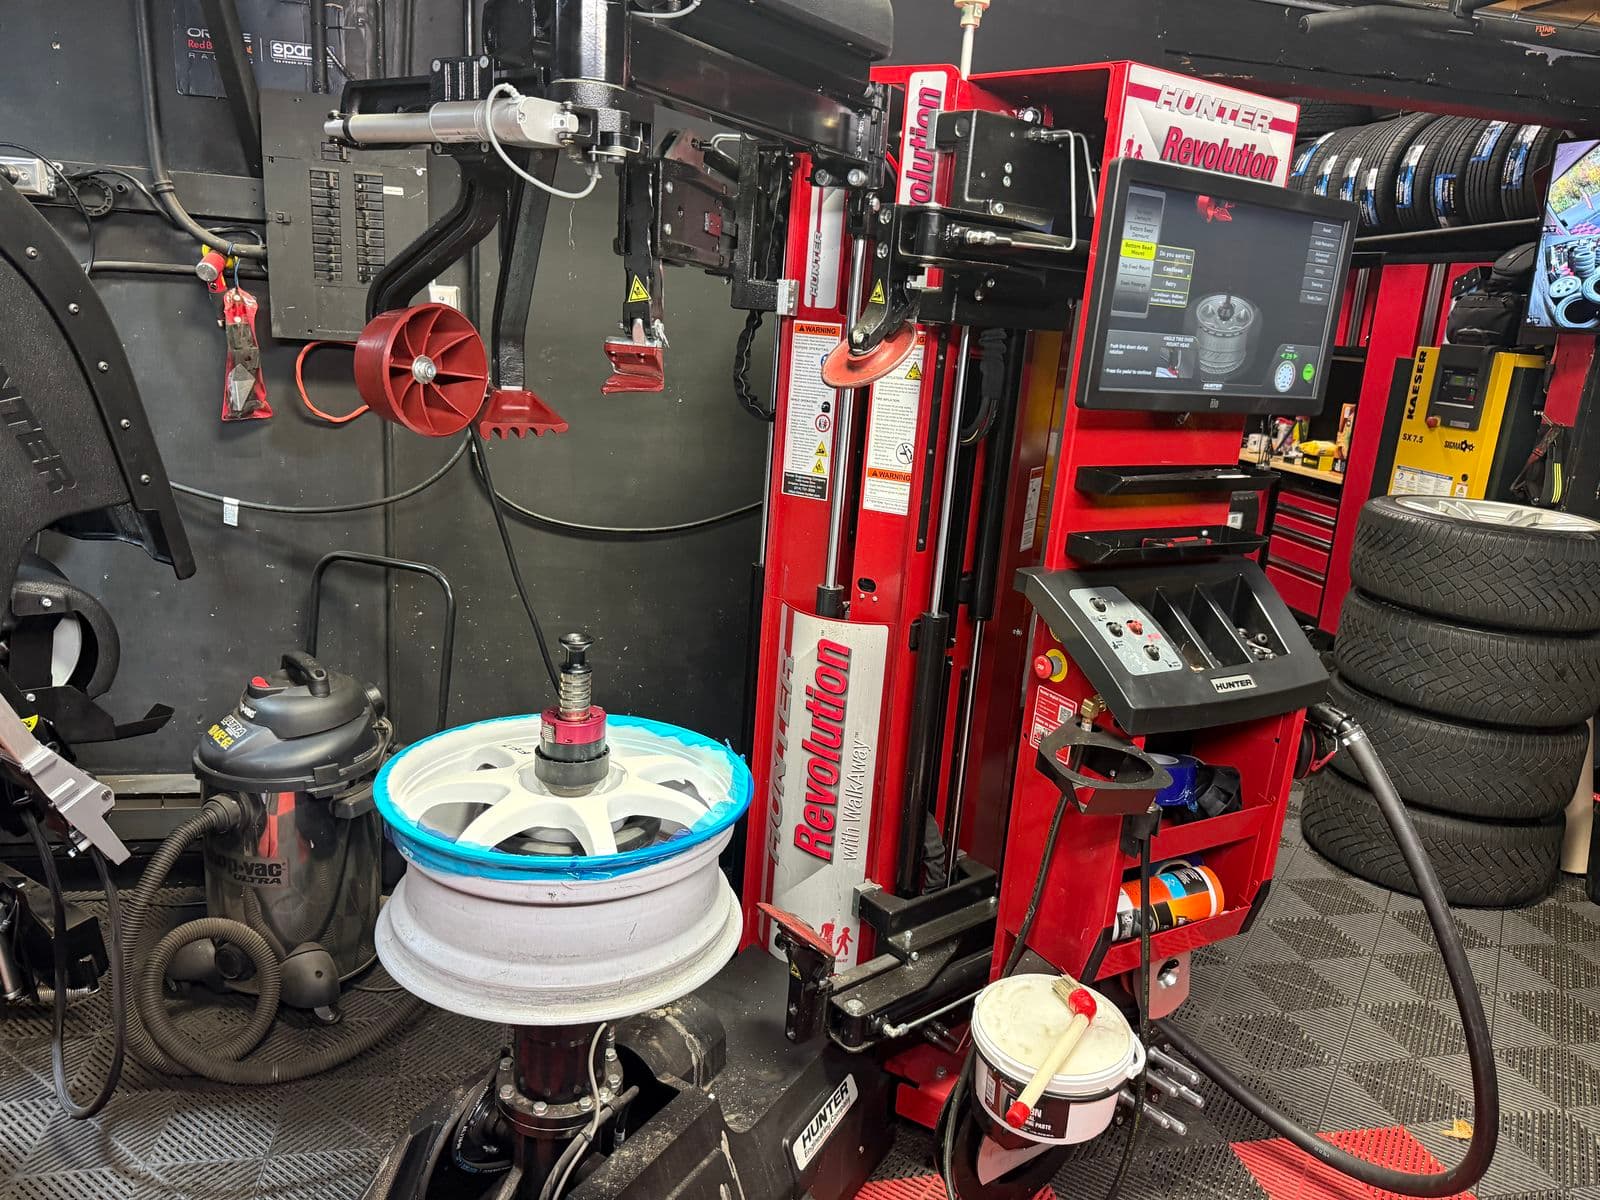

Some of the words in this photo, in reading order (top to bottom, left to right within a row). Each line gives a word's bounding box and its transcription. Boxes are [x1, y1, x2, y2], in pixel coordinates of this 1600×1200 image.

[273, 43, 325, 59] spar
[1155, 85, 1275, 133] HUNTER
[906, 86, 942, 206] olution
[1161, 126, 1278, 182] Revolution
[809, 230, 822, 298] HUNTER
[1125, 242, 1141, 250] Bottom
[1163, 265, 1183, 274] Continue
[1165, 281, 1177, 289] Retry
[806, 325, 837, 335] WARNING
[1407, 350, 1427, 420] KAESER
[879, 471, 912, 482] WARNING
[1215, 678, 1253, 692] HUNTER
[767, 654, 795, 867] HUNTER
[794, 637, 852, 862] Revolution
[843, 818, 861, 862] with
[233, 873, 282, 885] ULTRA
[801, 1081, 849, 1149] HUNTER
